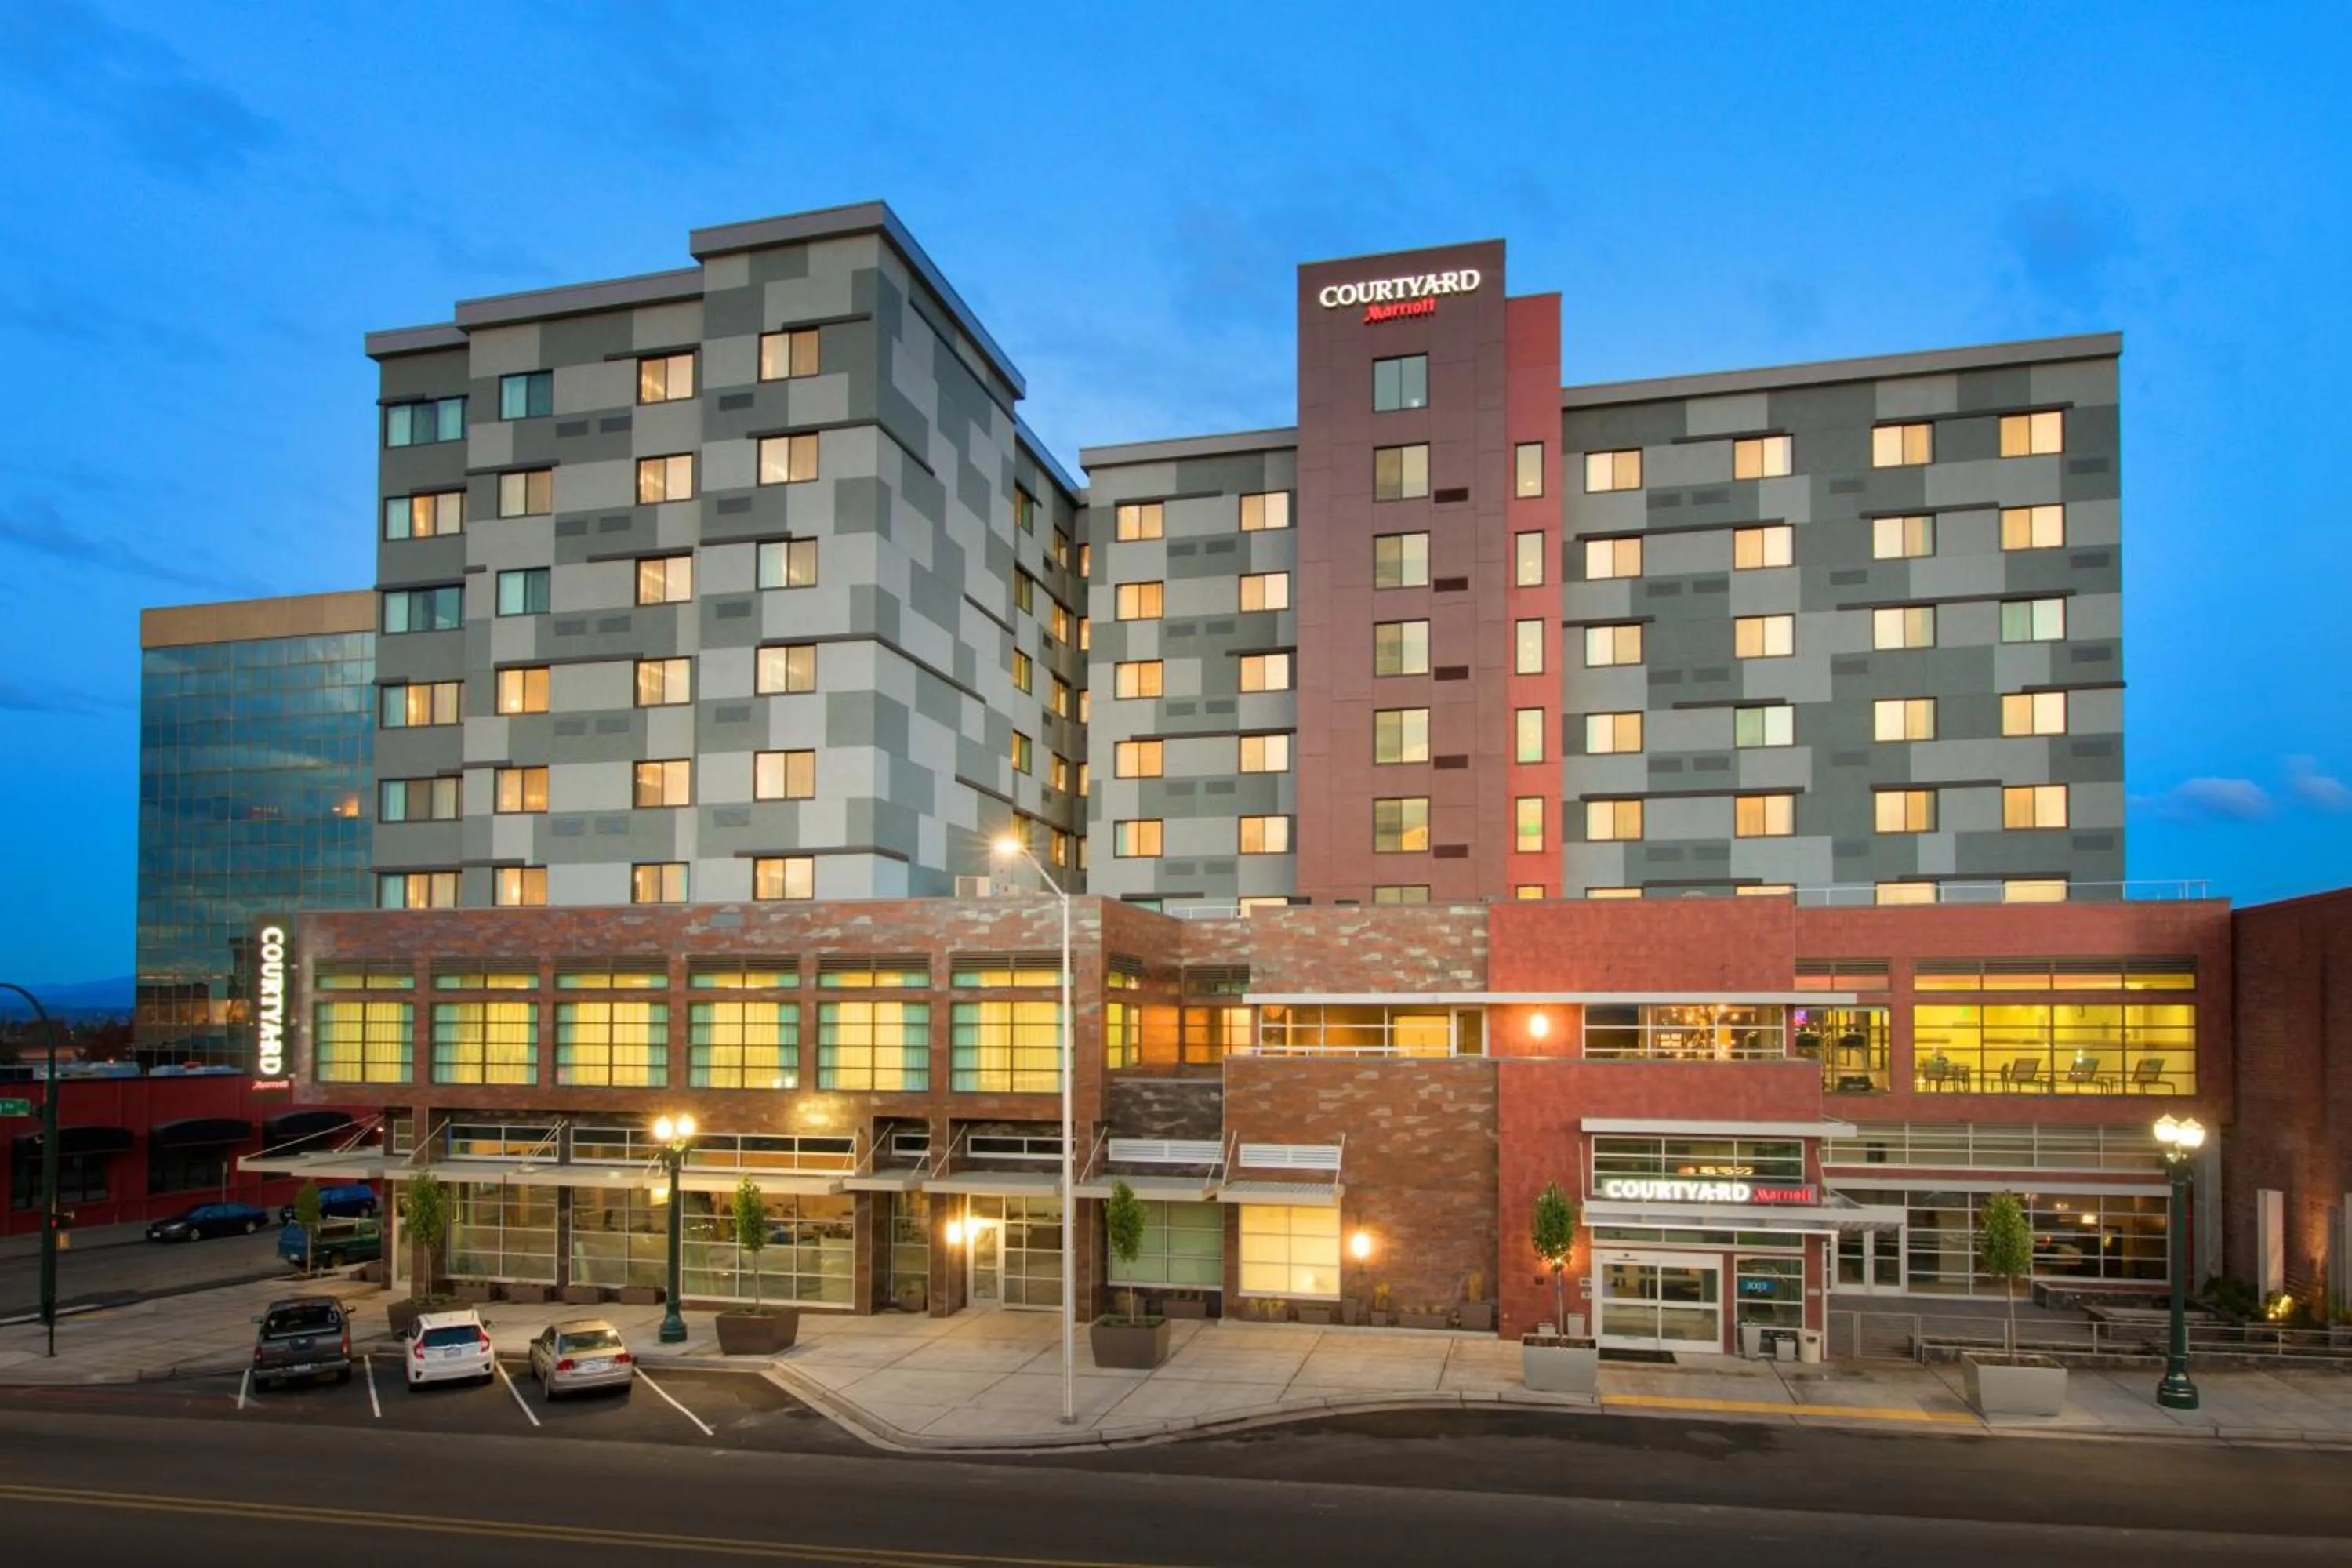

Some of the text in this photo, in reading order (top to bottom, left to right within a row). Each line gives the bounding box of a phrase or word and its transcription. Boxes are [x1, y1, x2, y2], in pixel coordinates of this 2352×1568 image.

[1319, 269, 1481, 308] COURTYARD
[1363, 297, 1436, 323] Marriott
[260, 926, 284, 1075] COURTYARD
[1605, 1179, 1813, 1203] COURTYARD Marriott
